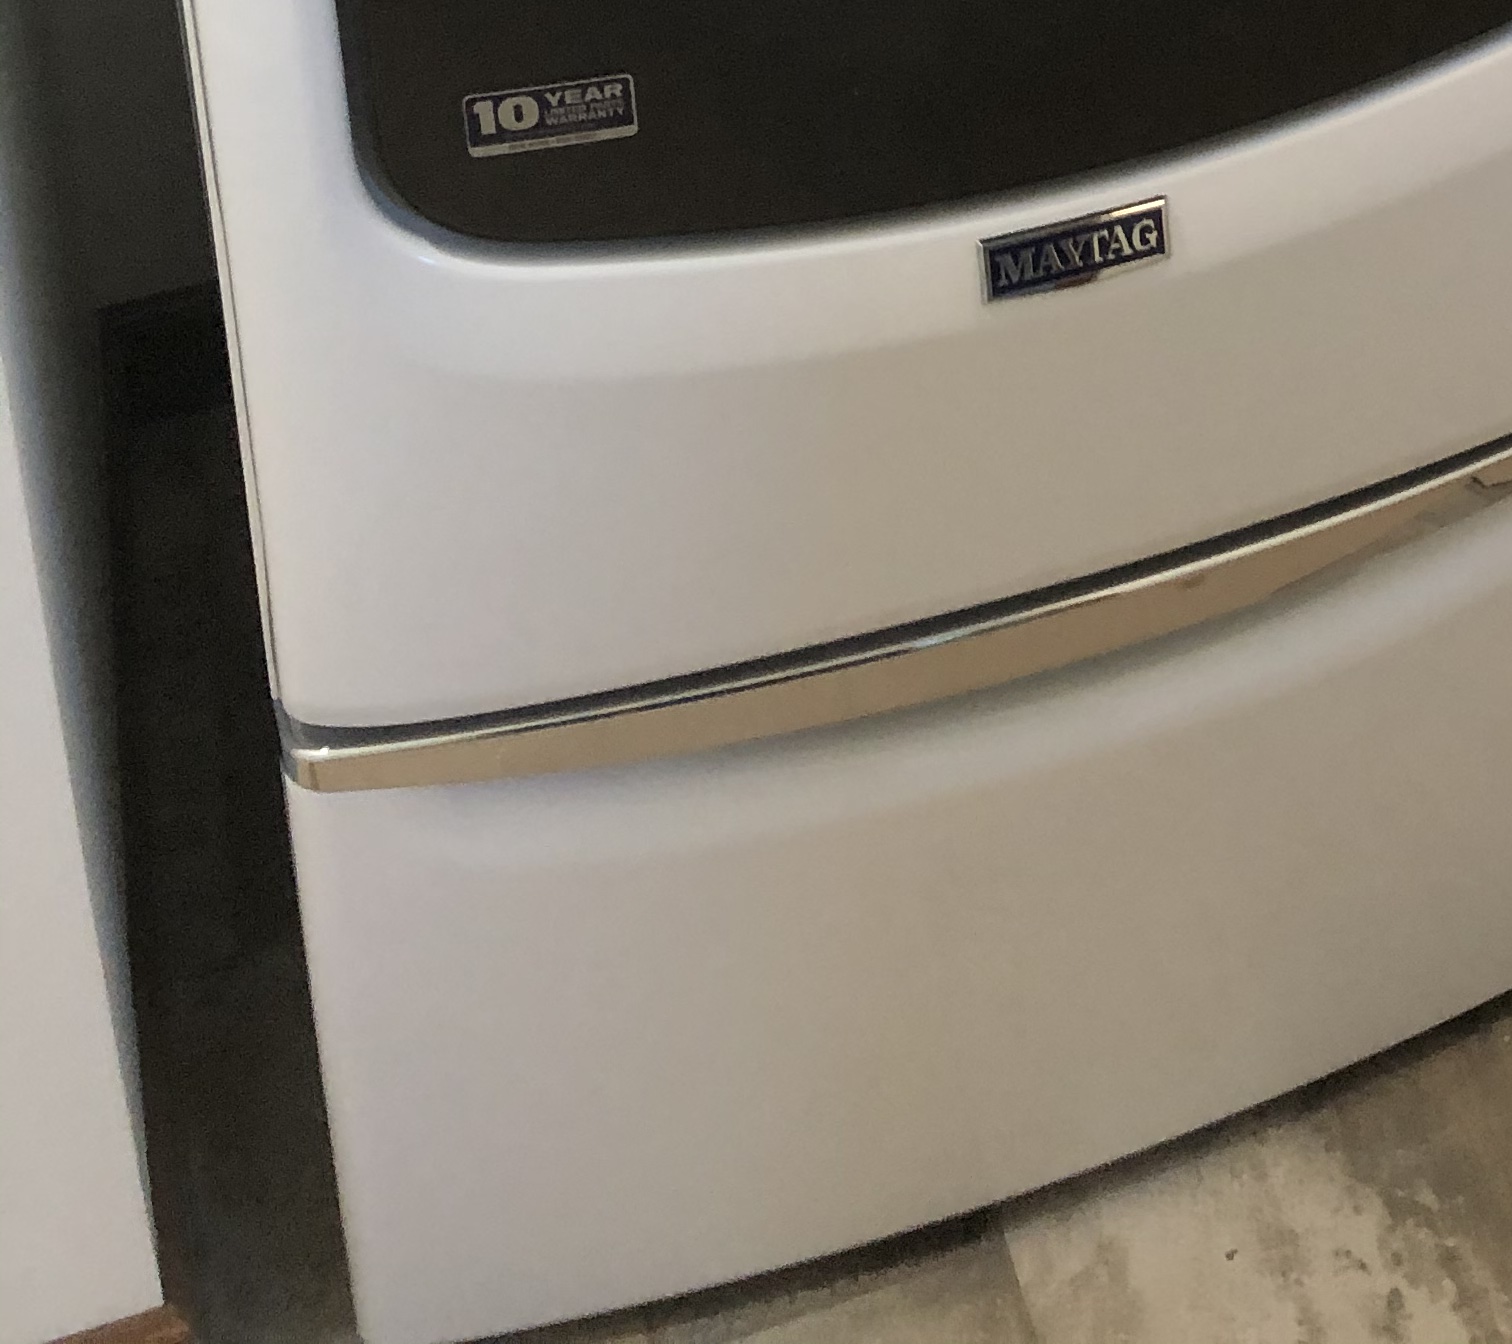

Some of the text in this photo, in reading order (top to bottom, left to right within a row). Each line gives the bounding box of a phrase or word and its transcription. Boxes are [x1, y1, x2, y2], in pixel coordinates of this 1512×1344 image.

[544, 83, 624, 108] YEAR
[473, 95, 540, 136] 10
[545, 105, 626, 126] WARRANTY
[995, 218, 1159, 287] MAYTAG
